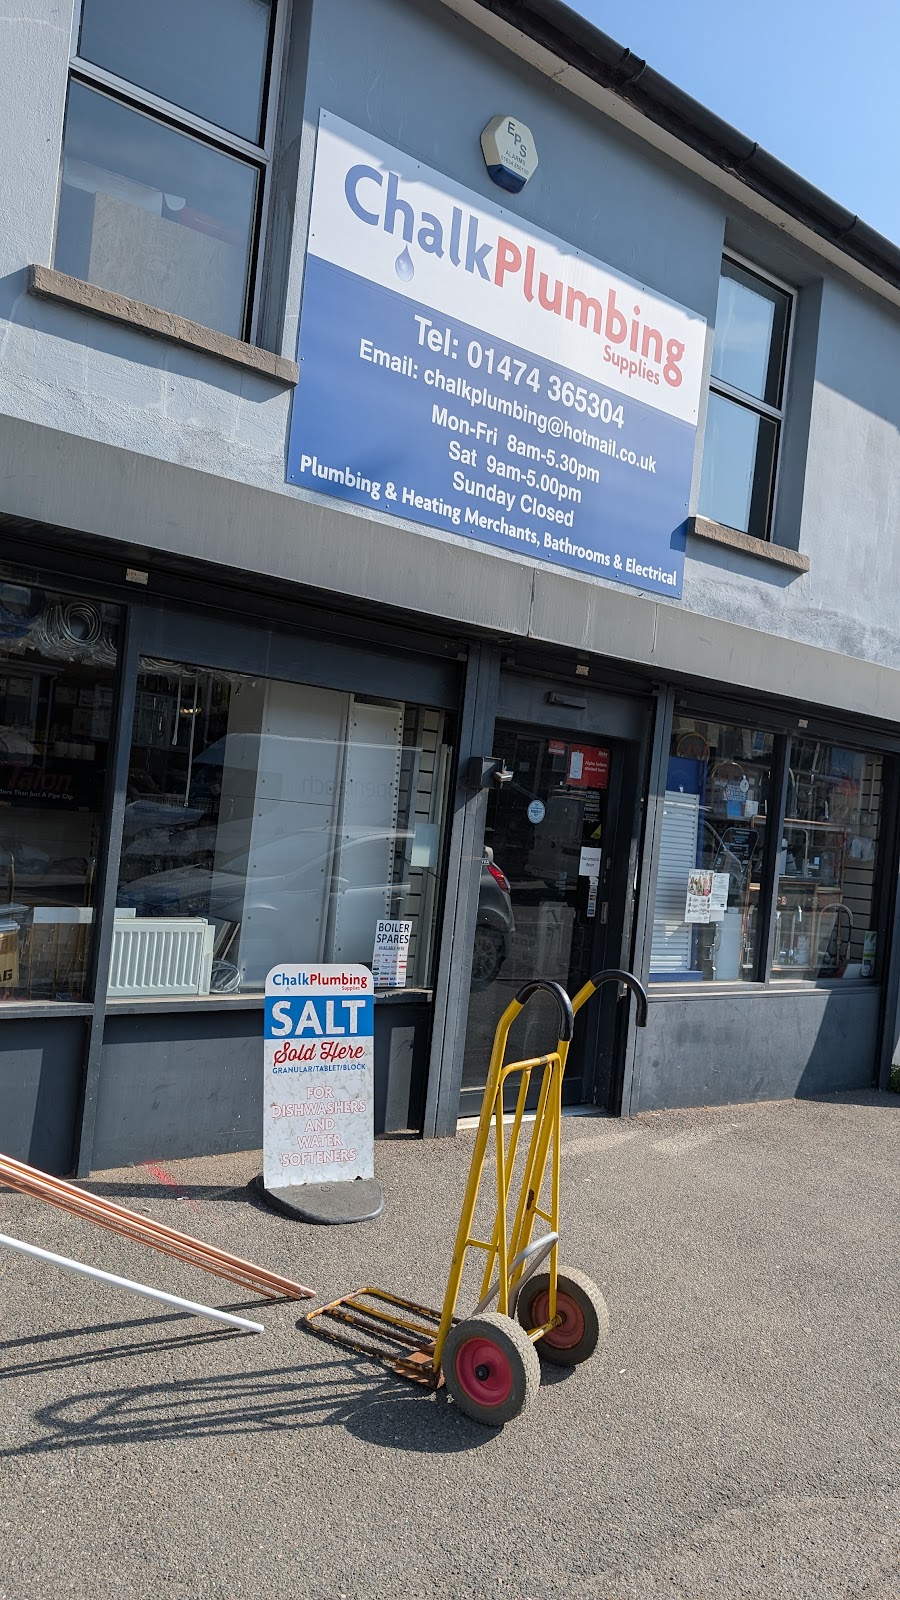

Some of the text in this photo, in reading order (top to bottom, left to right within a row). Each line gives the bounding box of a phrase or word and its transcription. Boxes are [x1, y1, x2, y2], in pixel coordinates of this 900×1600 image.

[506, 150, 526, 166] ALARMS
[344, 164, 685, 388] ChalkPlumbing
[414, 315, 624, 428] Tel: 01474 365304
[603, 344, 660, 386] Supplies
[360, 338, 657, 474] Email: chalkplumbing@hotmail.co.uk
[432, 404, 600, 485] Mon-Fri 8am-5.30pm
[448, 441, 582, 504] Sat 9am-5.00pm
[452, 472, 574, 529] Sunday Closed
[300, 454, 677, 587] Plumbing & Heating Merchants, Bathrooms & Electrical
[48, 792, 60, 800] Pipe
[378, 922, 410, 932] BOILER
[376, 934, 408, 943] SPARES
[0, 968, 12, 982] G
[272, 973, 368, 988] ChalkPlumbing
[272, 1000, 366, 1036] SALT
[274, 1041, 365, 1066] Sold Here
[272, 1064, 366, 1074] GRANULAR/TABLET/BLOCK
[307, 1086, 334, 1099] FOR
[272, 1100, 366, 1118] DISHWASHERS
[304, 1118, 335, 1132] AND
[297, 1134, 343, 1149] WATER
[281, 1148, 356, 1167] SOFTENERS
